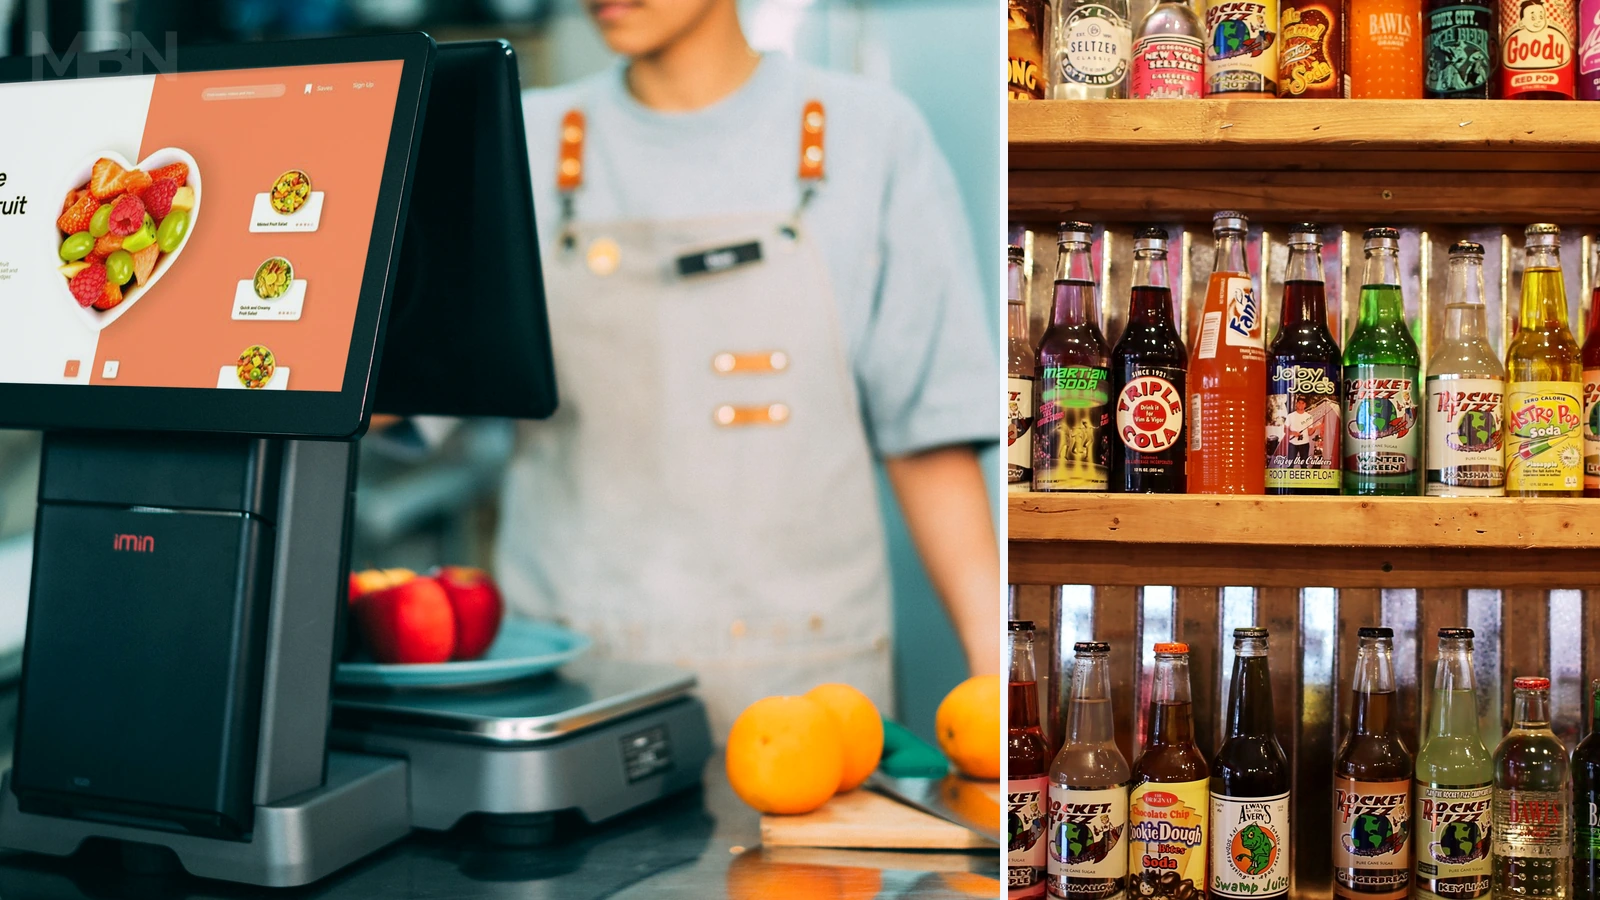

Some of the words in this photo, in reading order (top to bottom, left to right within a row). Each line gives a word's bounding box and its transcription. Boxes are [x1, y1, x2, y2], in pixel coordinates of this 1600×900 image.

[1205, 2, 1266, 29] ROCKET
[1207, 13, 1252, 38] FIZZ
[1369, 12, 1412, 37] BAWLS
[1071, 41, 1117, 55] SELTZER
[1507, 33, 1564, 65] Goody
[1144, 51, 1170, 61] NEW
[1172, 51, 1203, 65] YORK
[1148, 60, 1199, 73] SELTZER
[1062, 58, 1115, 84] BOTTLING
[1212, 73, 1260, 84] BANANA
[1290, 60, 1332, 94] Soda
[316, 84, 333, 92] Saves
[353, 81, 365, 90] Sign
[366, 81, 375, 90] Up
[1222, 81, 1248, 90] NUT
[1515, 76, 1533, 85] RED
[1131, 369, 1150, 378] SINCE
[1152, 369, 1167, 378] 1921
[1272, 365, 1323, 383] Joby
[1055, 378, 1099, 390] SODA
[1287, 377, 1335, 394] Joe's
[1344, 379, 1412, 400] ROCKET
[1118, 381, 1181, 416] TRIPLE
[1348, 391, 1400, 411] FIZZ
[1524, 397, 1538, 405] ZERO
[1151, 416, 1165, 424] Vigor
[1447, 402, 1498, 423] FIZZ
[1510, 404, 1554, 433] ASTRO
[1122, 425, 1178, 449] COLA
[1530, 426, 1561, 439] Soda
[1273, 455, 1293, 468] Enjoy
[1293, 457, 1304, 465] the
[1306, 456, 1332, 466] Outdoors
[1526, 461, 1559, 469] Pineapple
[1269, 470, 1287, 480] ROOT
[1289, 470, 1311, 480] BEER
[1313, 470, 1335, 480] FLOAT
[1336, 789, 1406, 811] ROCKET
[1443, 791, 1459, 799] ROCKET
[1048, 797, 1111, 815] ROCKET
[1133, 806, 1167, 818] Chocolate
[1169, 810, 1190, 819] Chip
[1343, 804, 1395, 824] FIZZ
[1420, 799, 1491, 820] ROCKET
[1509, 800, 1559, 824] BAWLS
[1050, 811, 1097, 830] FIZZ
[1431, 812, 1483, 832] FIZZ
[1158, 844, 1187, 854] Bites
[1142, 855, 1177, 869] Soda
[1215, 876, 1259, 895] Swamp
[1263, 876, 1288, 892] Juice
[1438, 883, 1463, 892] KEY
[1465, 880, 1489, 892] LIME
